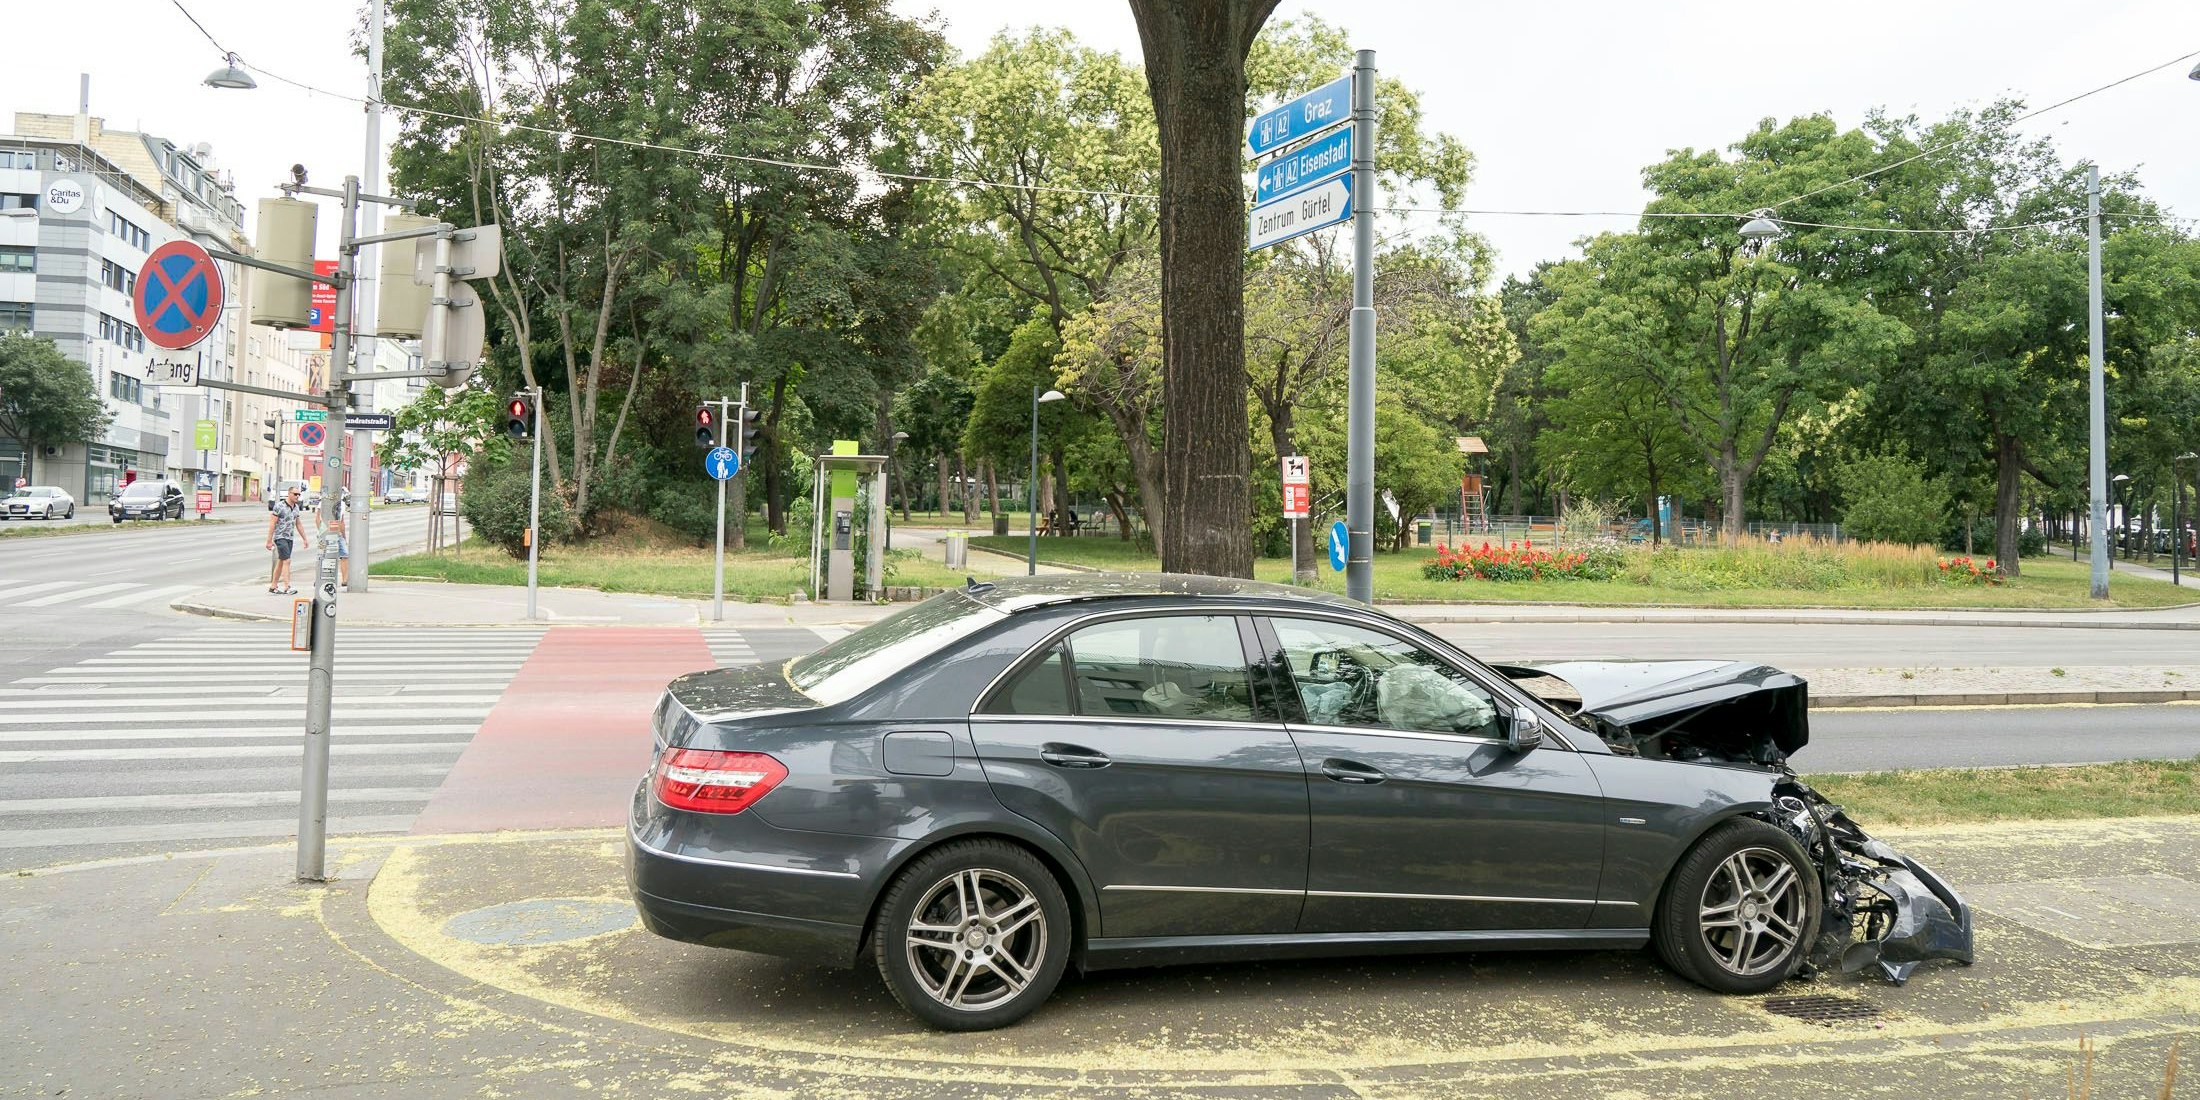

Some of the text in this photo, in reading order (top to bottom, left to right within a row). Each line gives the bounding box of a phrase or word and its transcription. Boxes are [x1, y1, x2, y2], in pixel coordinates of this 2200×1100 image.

[1277, 98, 1332, 136] A2 Graz
[1286, 137, 1348, 183] A2 Eisenstadt
[50, 188, 81, 198] Caritas
[50, 196, 69, 204] &Du
[1258, 192, 1331, 236] Zentrum Gürtel
[345, 417, 388, 425] undratstraße
